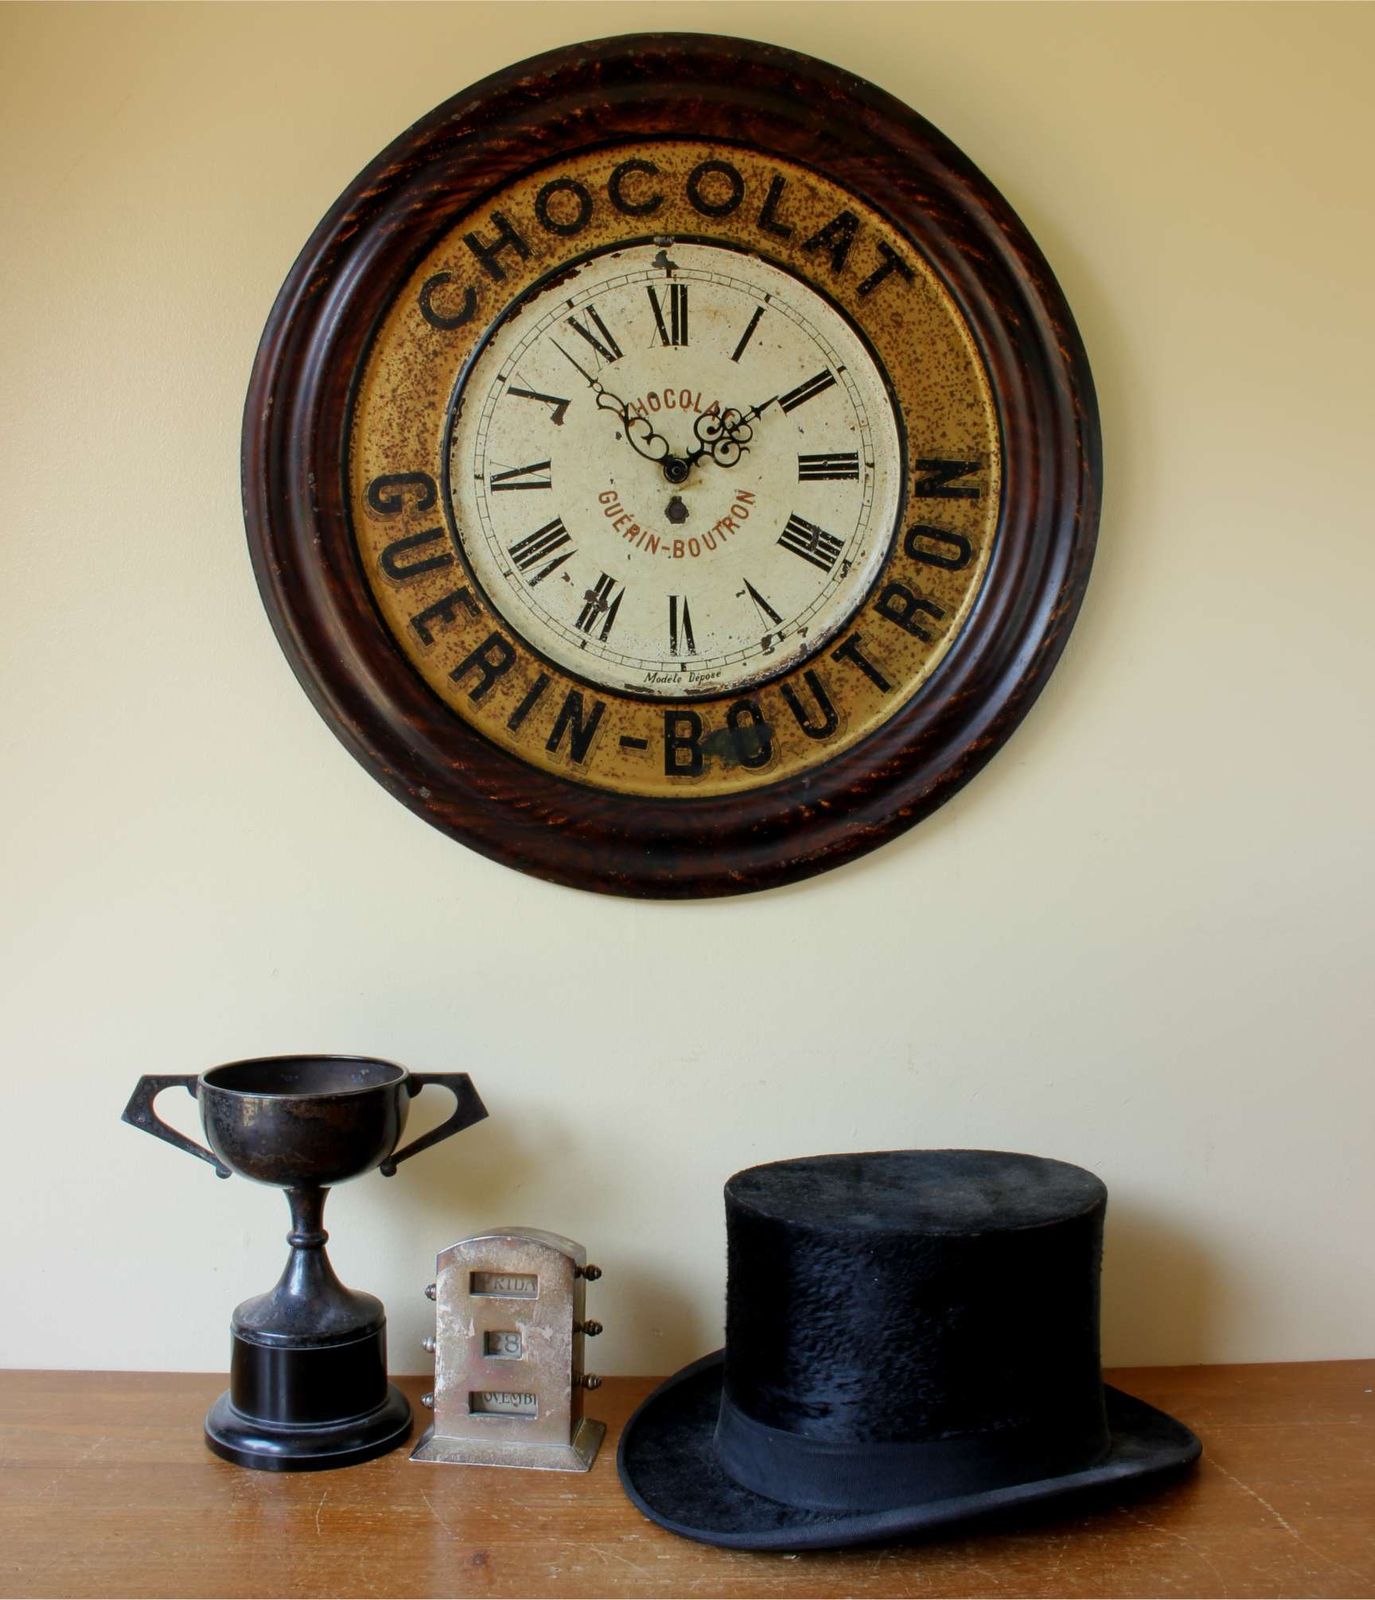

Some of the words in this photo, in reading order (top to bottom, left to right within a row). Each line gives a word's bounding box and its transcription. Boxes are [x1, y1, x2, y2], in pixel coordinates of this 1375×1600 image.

[419, 159, 919, 331] CHOCOLAT
[645, 282, 692, 350] XII
[728, 304, 768, 365] I
[618, 388, 736, 428] HOCOLA
[777, 366, 838, 416] II
[797, 450, 860, 484] III
[507, 513, 580, 589] VIII
[598, 488, 757, 559] GUÉRIN-BOUTRON
[776, 510, 848, 575] IIII
[666, 594, 699, 657] VI
[742, 577, 787, 634] V
[493, 1277, 538, 1292] RIDA
[484, 1391, 537, 1405] OVEMB
